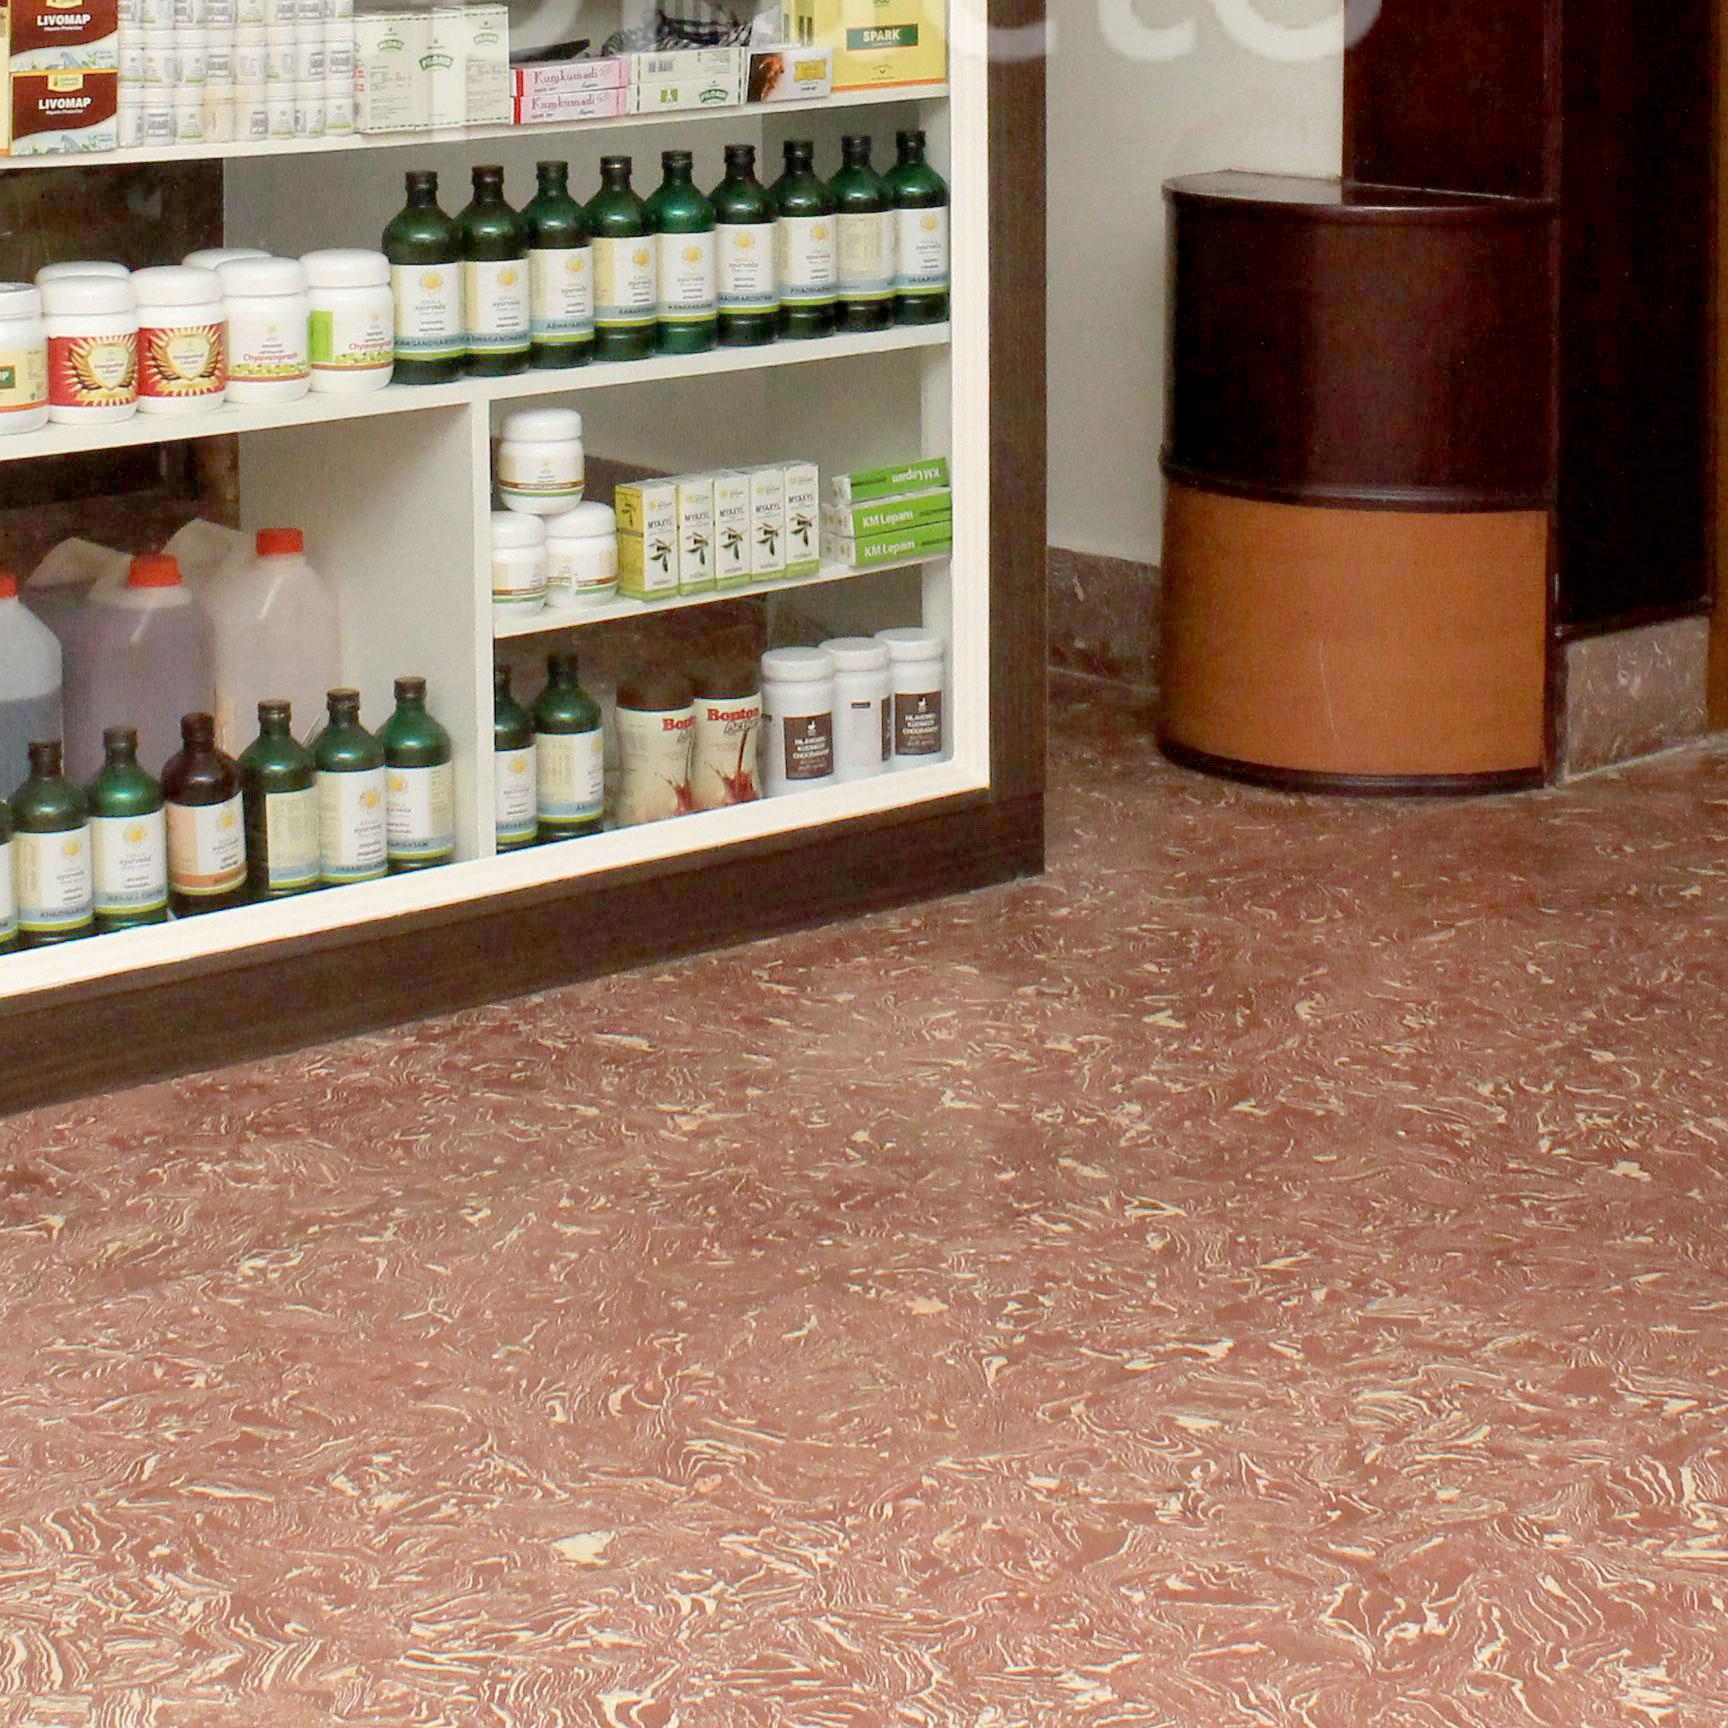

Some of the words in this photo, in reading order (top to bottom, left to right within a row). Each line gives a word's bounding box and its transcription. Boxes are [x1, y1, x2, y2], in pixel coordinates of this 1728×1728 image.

[37, 14, 92, 26] LIVOMAP
[862, 28, 902, 42] SPARK
[534, 68, 598, 84] Kumkumadi
[38, 97, 92, 110] LIVOMAP
[892, 469, 923, 482] Lepam
[924, 467, 941, 480] KM
[862, 515, 880, 528] KM
[880, 510, 913, 526] Lepam
[864, 545, 882, 557] KM
[882, 540, 915, 555] Lepam
[706, 707, 760, 721] Bonton
